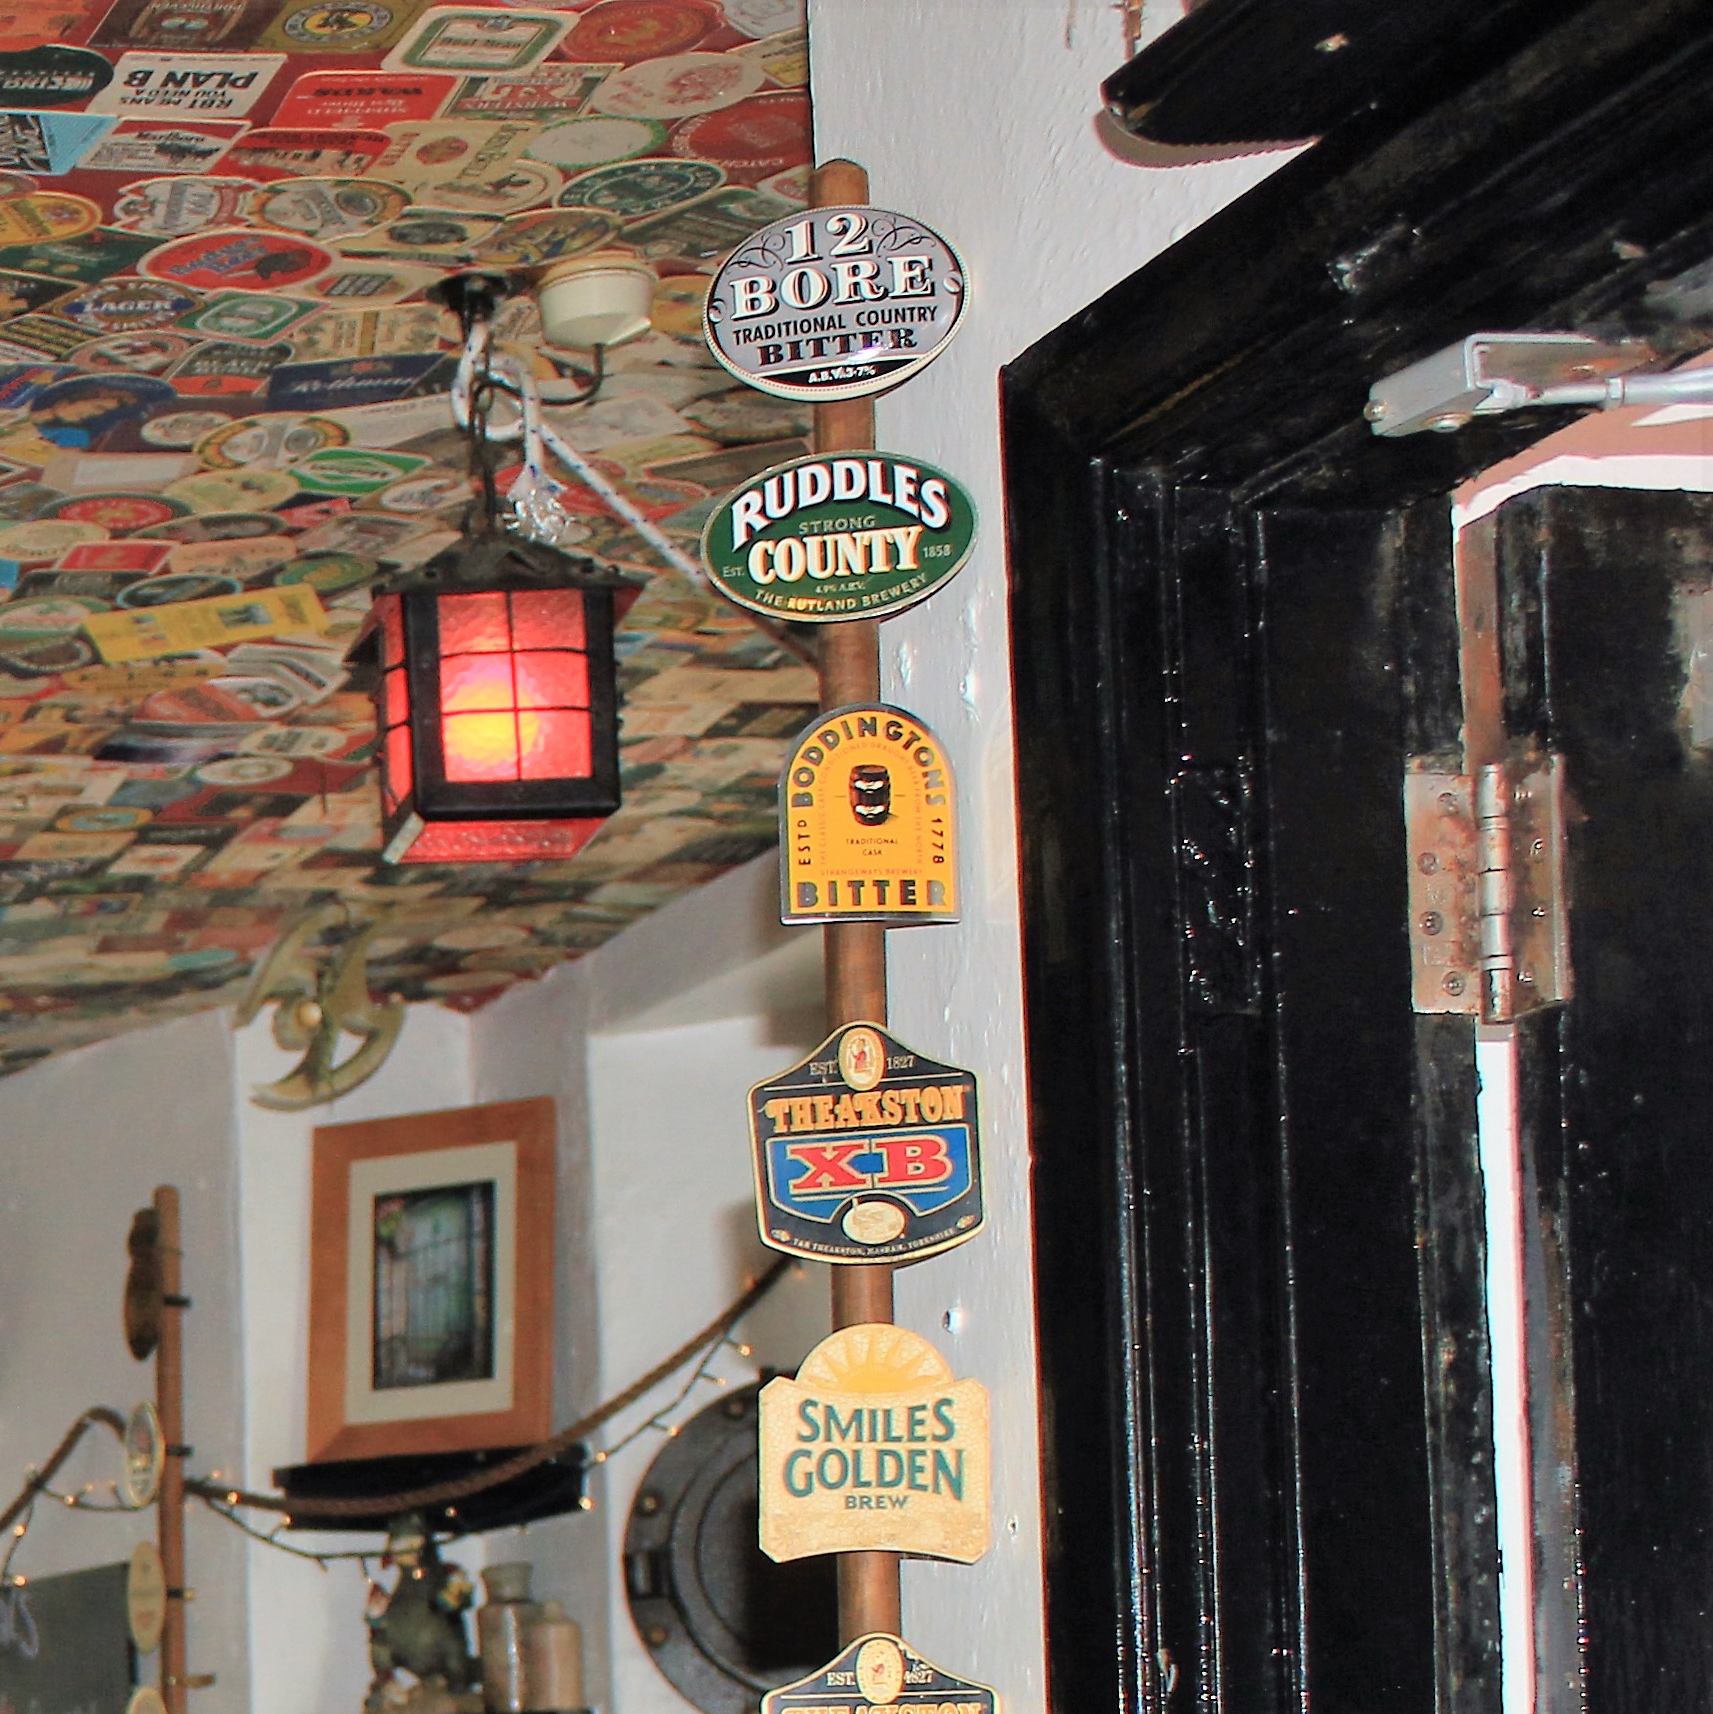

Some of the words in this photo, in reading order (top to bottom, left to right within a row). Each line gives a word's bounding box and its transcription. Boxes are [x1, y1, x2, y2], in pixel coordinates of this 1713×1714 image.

[123, 69, 155, 88] B
[160, 69, 260, 89] PLAN
[784, 212, 873, 264] 12
[728, 253, 937, 322] BORE
[731, 313, 847, 347] TRADITIONAL
[855, 303, 939, 328] COUNTRY
[756, 326, 918, 366] BITTER
[730, 458, 952, 553] RUDDLES
[797, 515, 876, 536] STRONG
[747, 525, 925, 586] COUNTY
[753, 588, 784, 609] THE
[860, 571, 930, 609] BREWERY
[791, 716, 947, 809] BODDINGTONS
[845, 837, 899, 846] TRADITIONAL
[862, 848, 883, 857] CASK
[931, 817, 945, 865] 1778
[796, 879, 947, 909] BITTER
[758, 1084, 971, 1134] THEAKSTON
[785, 1122, 957, 1195] XB
[797, 1397, 958, 1444] SMILES
[782, 1446, 968, 1502] GOLDEN
[844, 1494, 912, 1511] BREW
